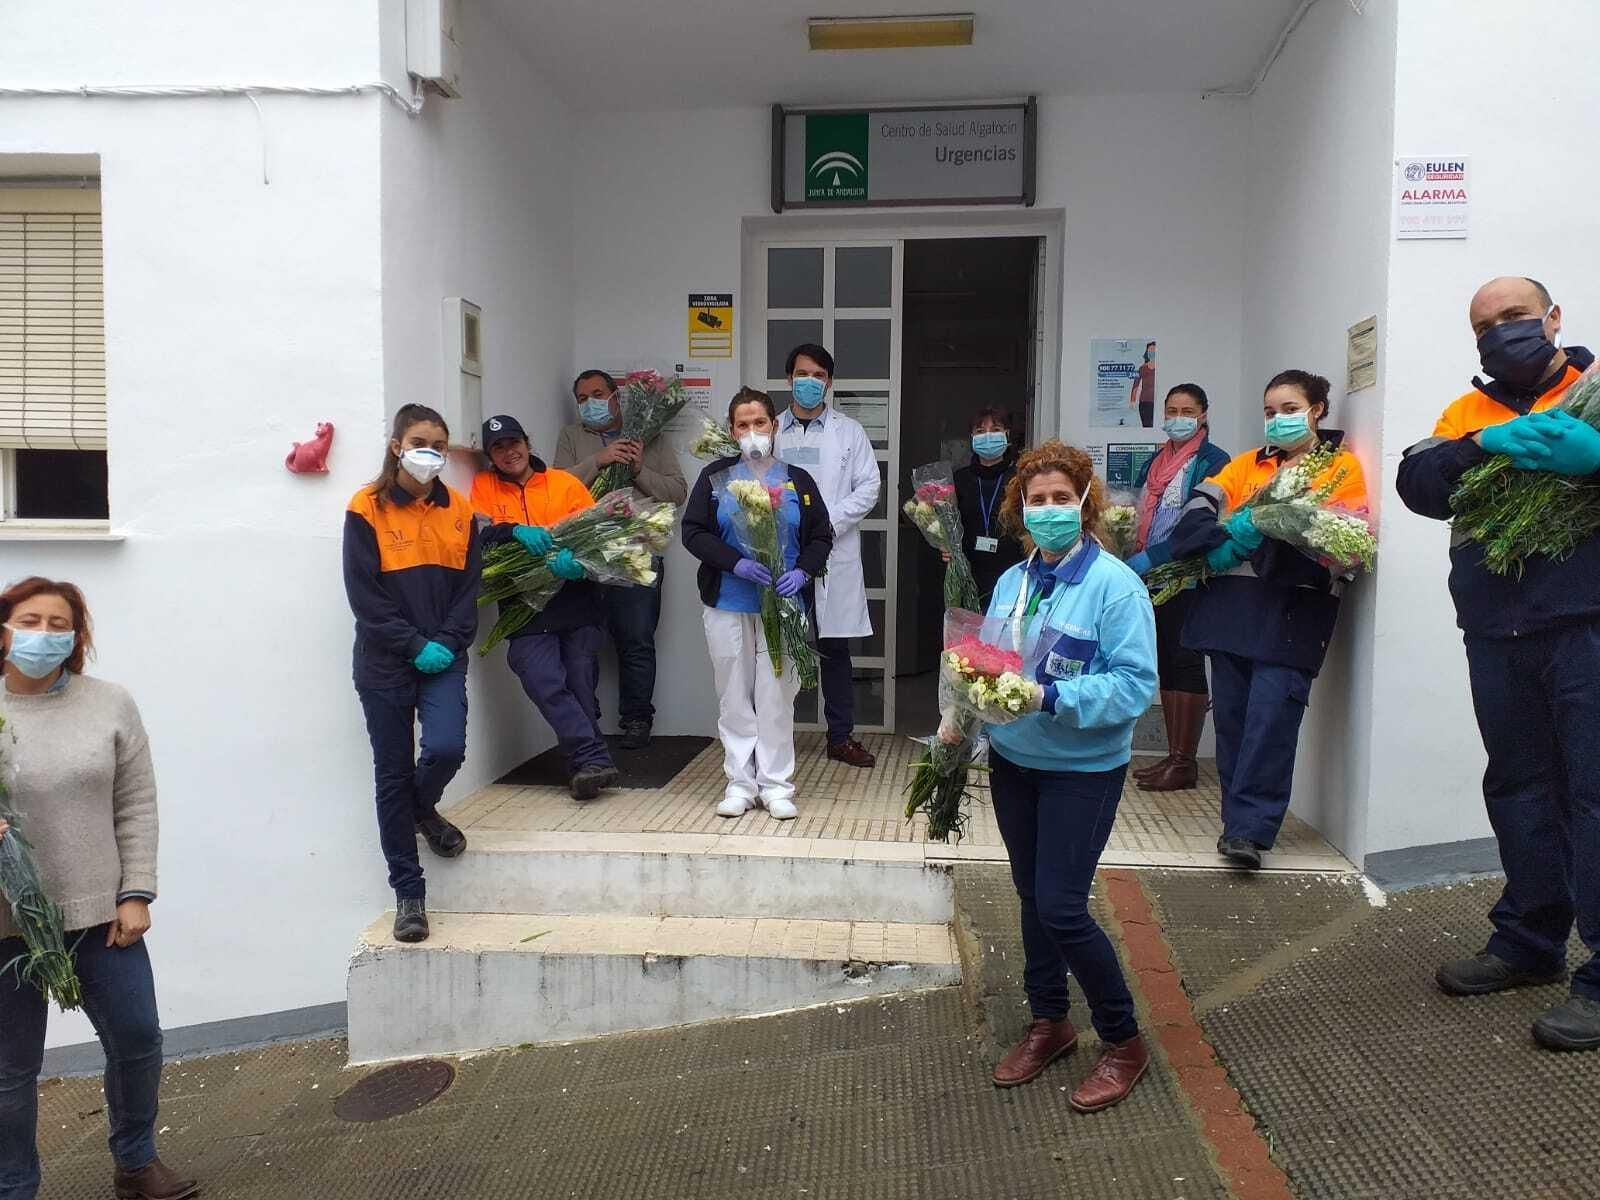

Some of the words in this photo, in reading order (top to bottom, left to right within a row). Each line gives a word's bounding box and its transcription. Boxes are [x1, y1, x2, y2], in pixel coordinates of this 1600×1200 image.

[881, 124, 916, 138] Centro
[919, 122, 932, 137] de
[935, 121, 965, 137] Salud
[935, 144, 1017, 166] Urgencias
[1426, 162, 1465, 173] EULEN
[1402, 189, 1467, 201] ALARMA
